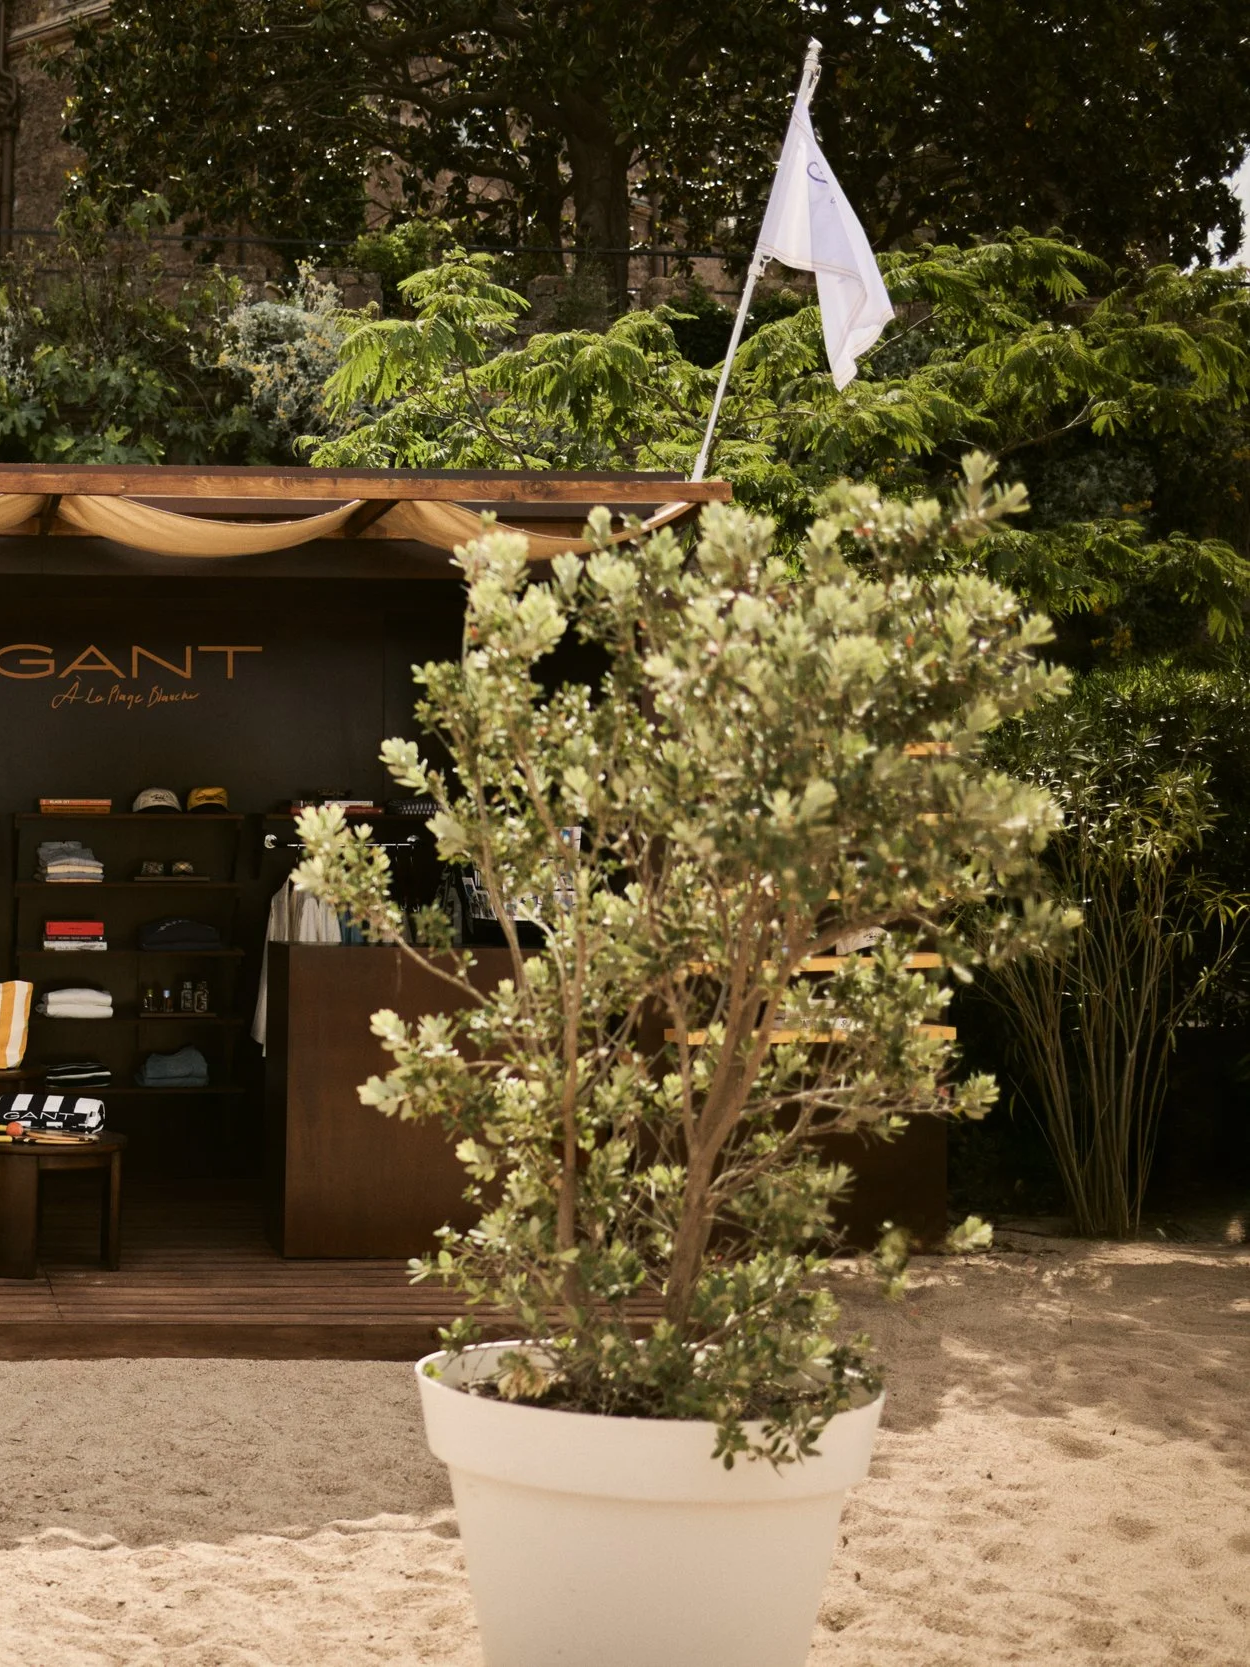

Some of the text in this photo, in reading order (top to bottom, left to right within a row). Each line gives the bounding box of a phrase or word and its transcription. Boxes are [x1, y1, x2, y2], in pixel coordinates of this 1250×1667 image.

[107, 684, 144, 709] Plage
[147, 685, 200, 708] Blanche
[3, 1111, 75, 1121] GANT
